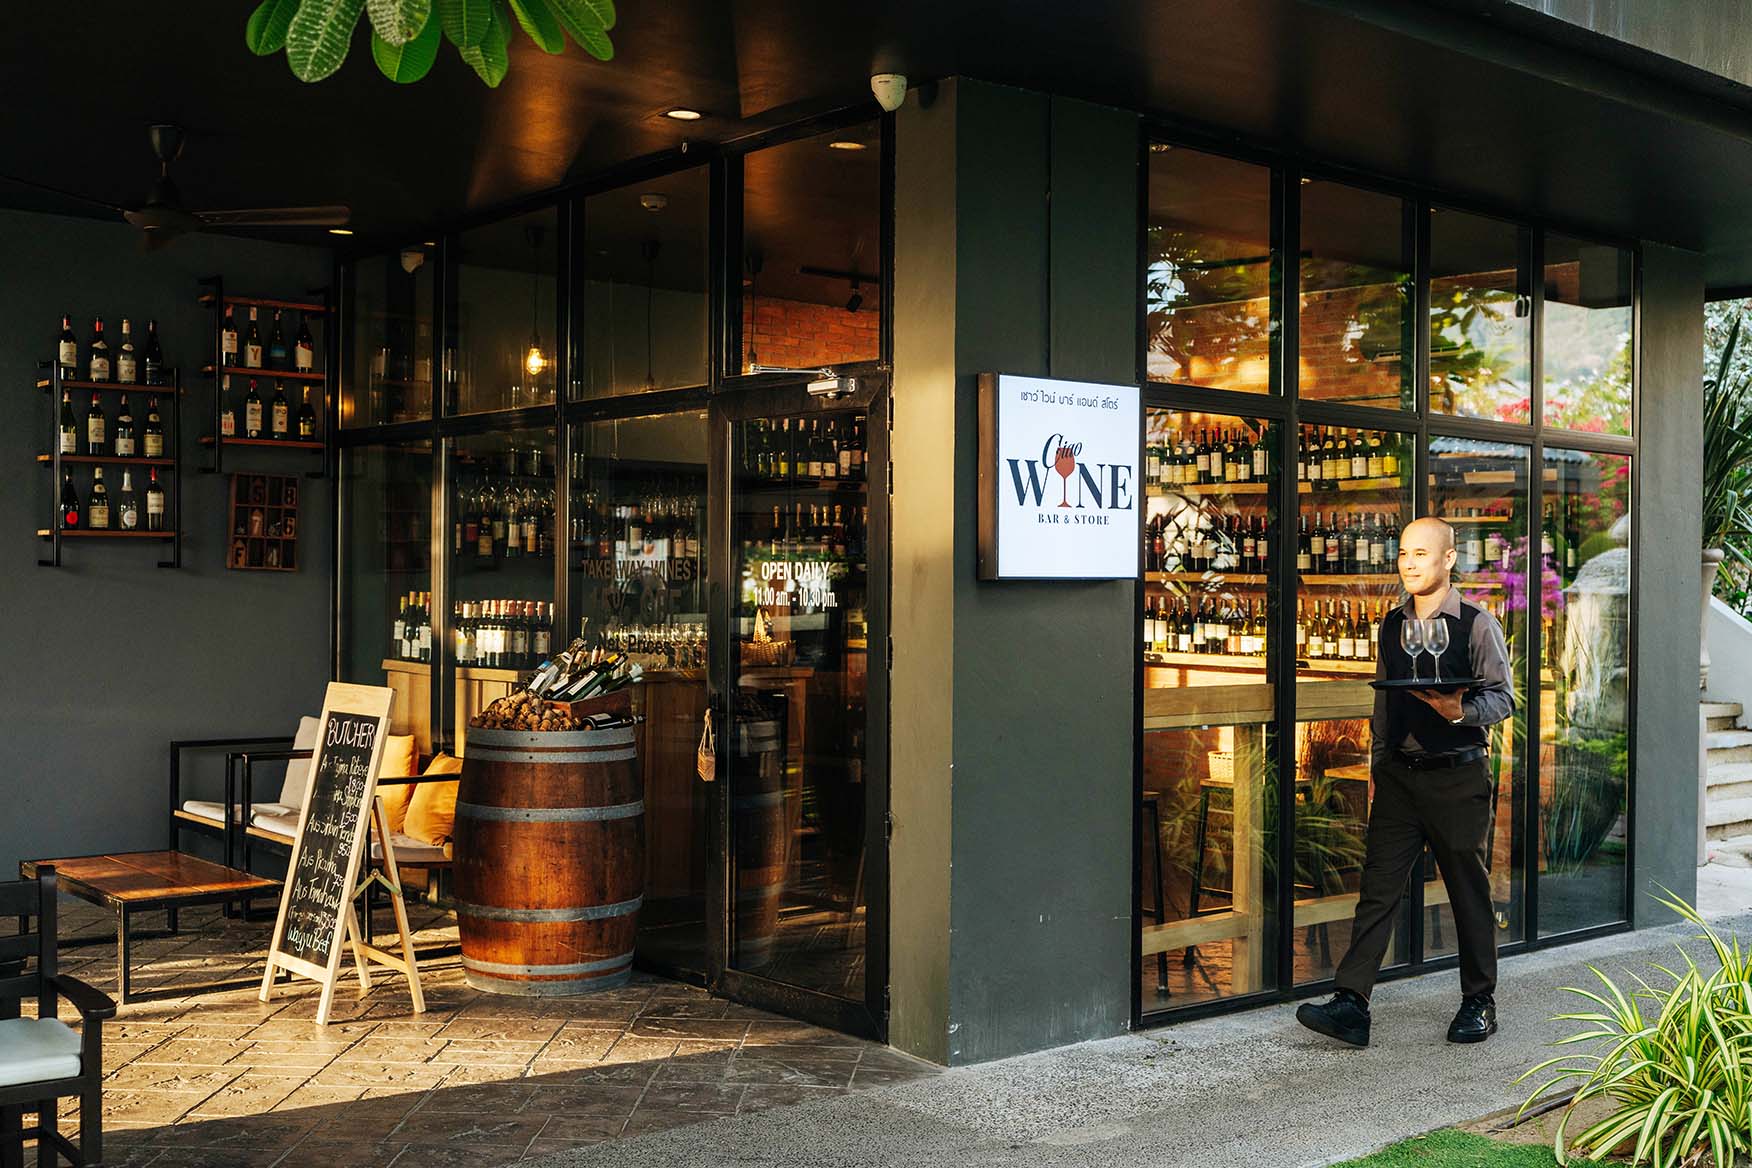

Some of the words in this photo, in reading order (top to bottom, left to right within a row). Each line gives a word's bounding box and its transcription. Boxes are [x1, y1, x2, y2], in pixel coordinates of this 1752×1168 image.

[1040, 390, 1056, 404] ไวน์
[1058, 393, 1074, 406] บาร์
[1076, 395, 1099, 408] แอนด์
[1101, 396, 1119, 410] สโตร์
[1041, 433, 1083, 469] Ciao
[1006, 448, 1133, 510] WINE
[1038, 513, 1059, 524] BAR
[1064, 515, 1070, 524] &
[1074, 514, 1110, 525] STORE
[650, 559, 692, 581] WINES
[761, 561, 792, 580] OPEN
[795, 561, 830, 580] DAILY
[753, 587, 775, 606] 11.00
[775, 590, 791, 606] am.
[798, 587, 821, 607] 10.30
[821, 590, 838, 611] pm.
